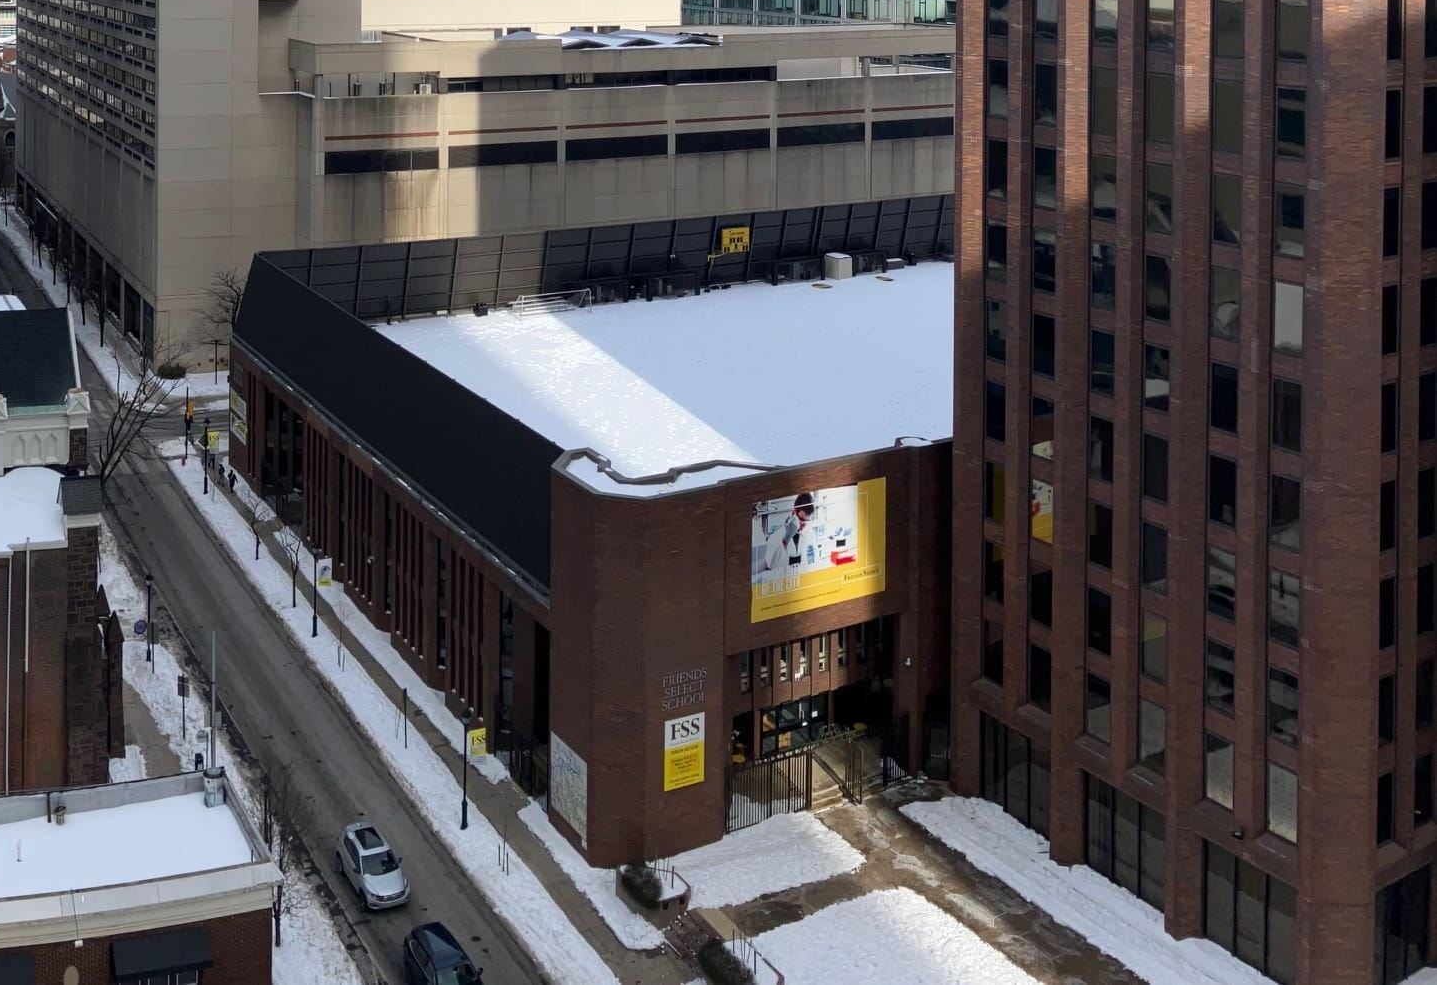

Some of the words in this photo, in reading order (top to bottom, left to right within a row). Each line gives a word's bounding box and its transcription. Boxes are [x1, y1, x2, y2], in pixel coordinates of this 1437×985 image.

[663, 667, 707, 688] FRIENDS
[665, 679, 706, 697] SELECT
[662, 691, 707, 711] SCHOOL
[670, 717, 700, 741] FSS
